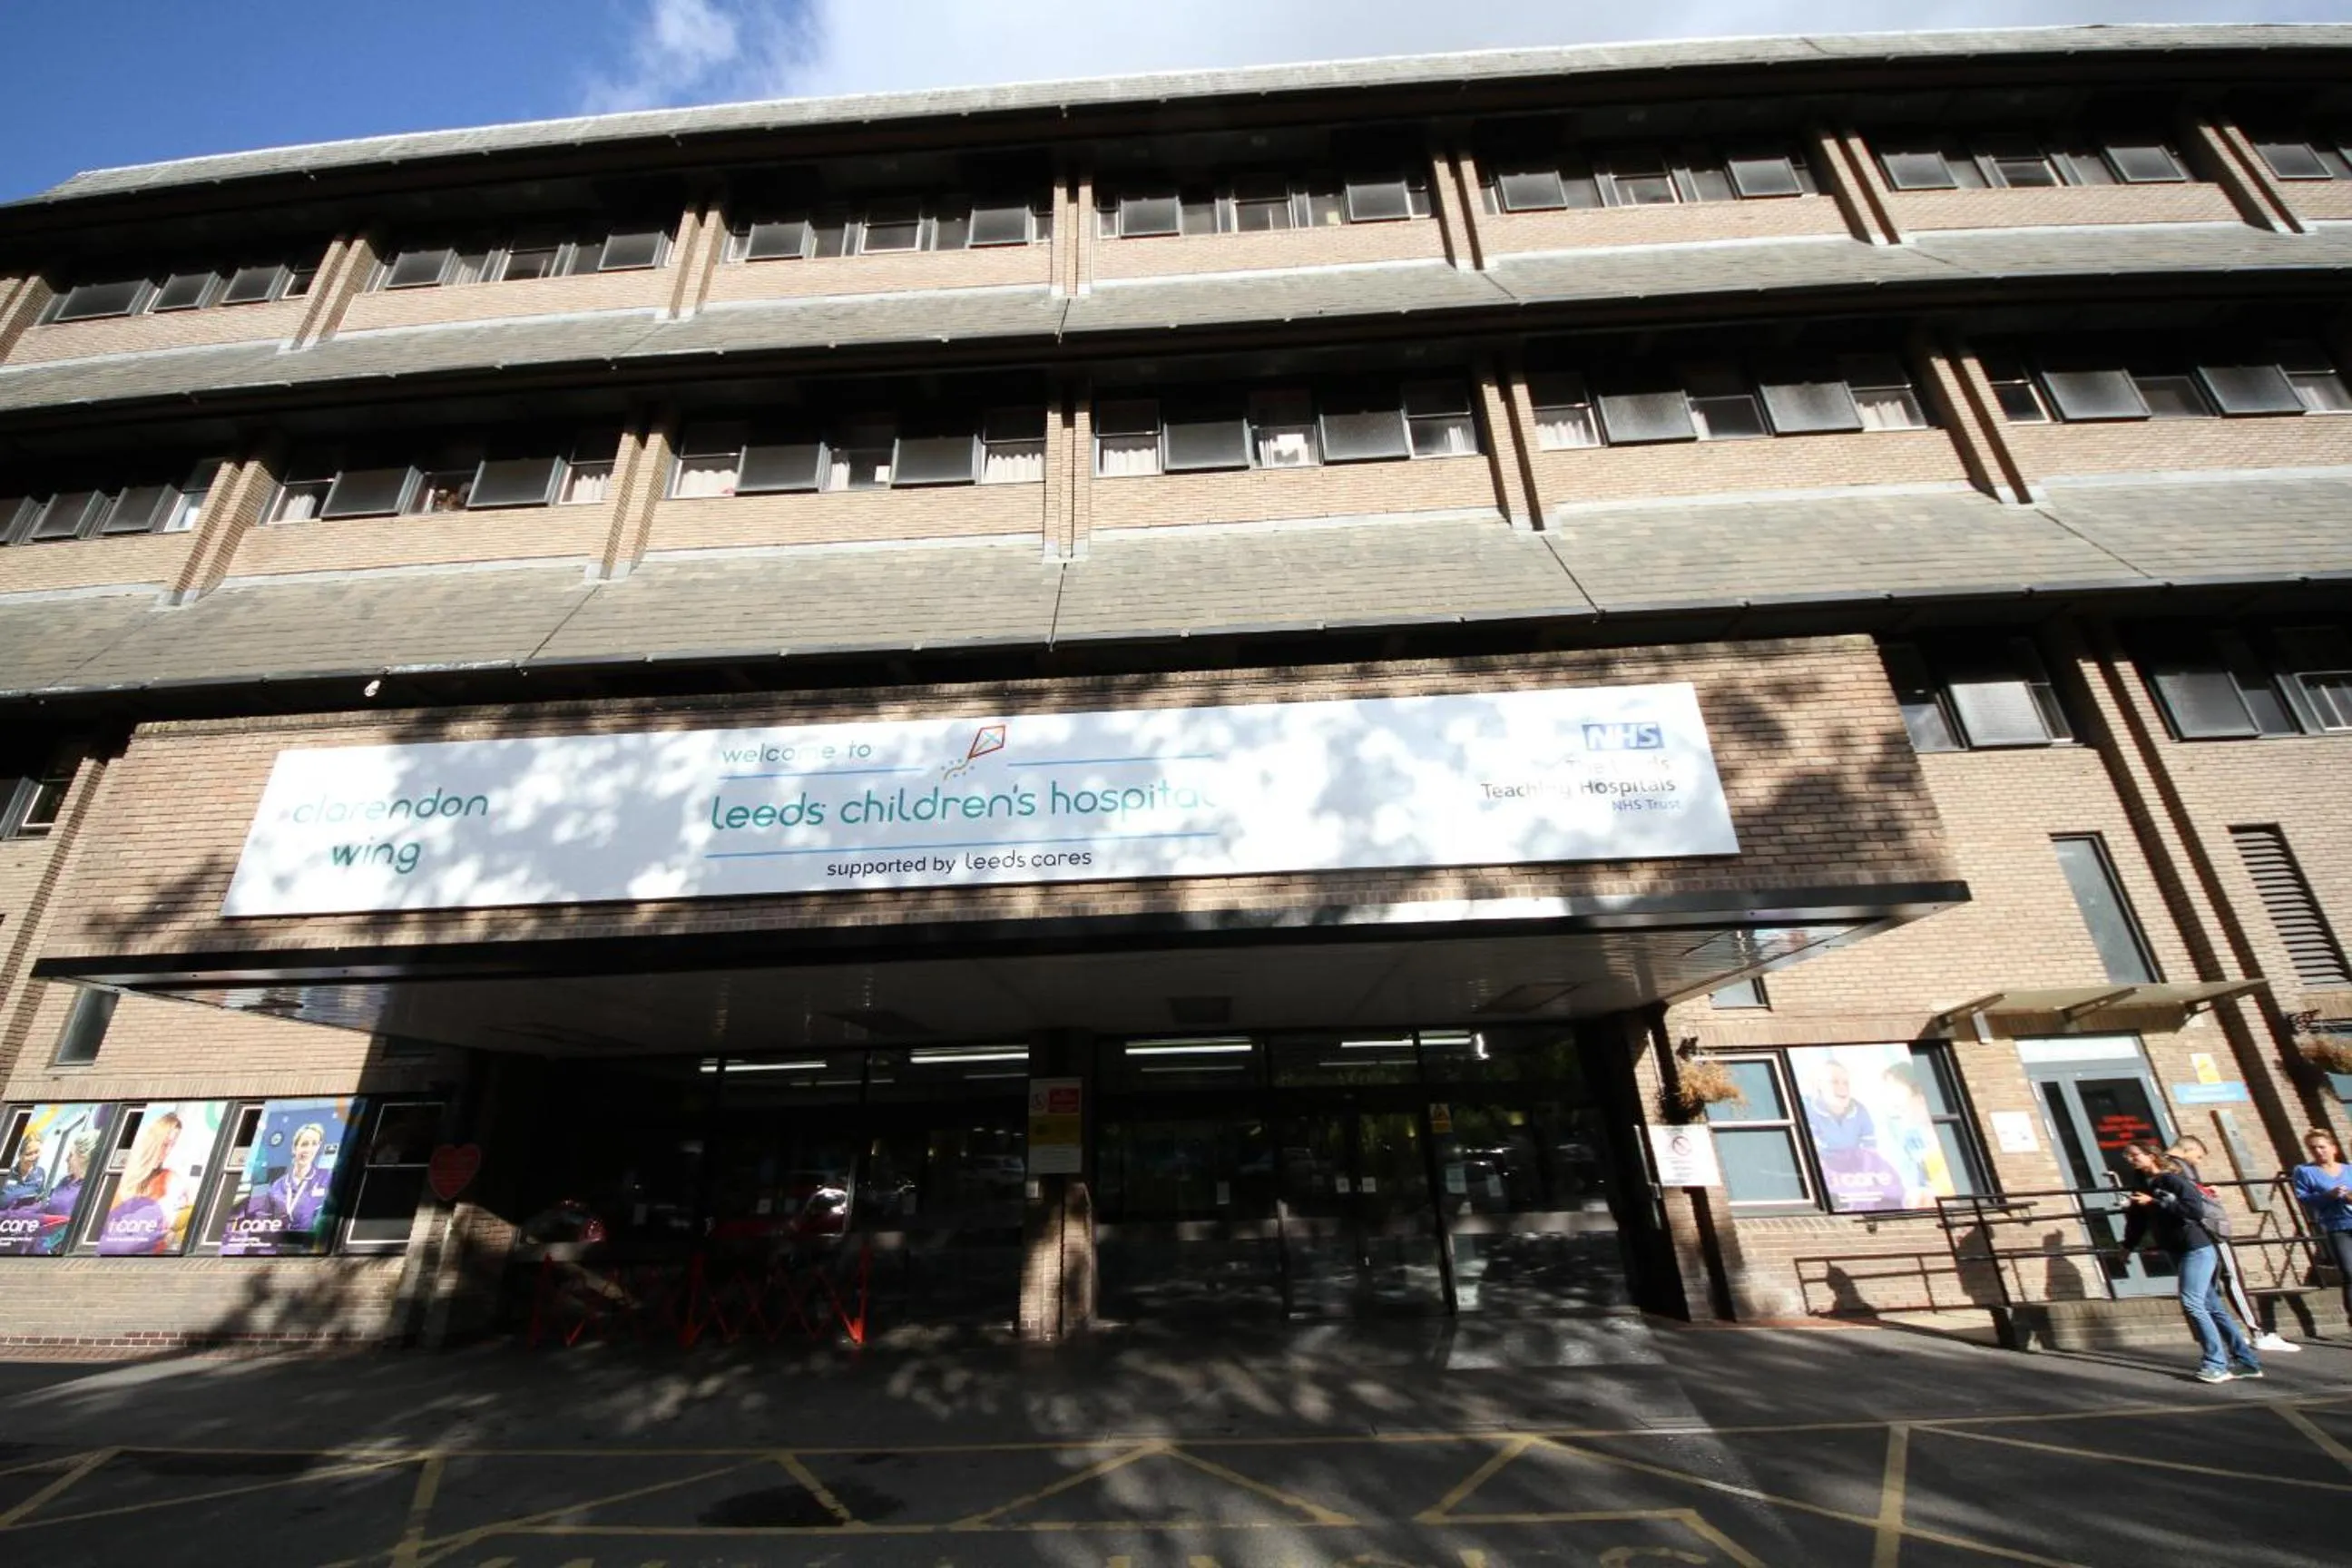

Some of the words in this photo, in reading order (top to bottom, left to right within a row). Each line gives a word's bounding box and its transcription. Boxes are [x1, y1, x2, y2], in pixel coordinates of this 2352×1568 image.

[1586, 723, 1661, 750] NHS
[722, 742, 836, 764] welcoe
[848, 740, 873, 760] to
[1481, 780, 1573, 800] Teachg
[1580, 778, 1677, 798] Hospitals
[292, 786, 489, 824] clarendon
[710, 794, 827, 831] leeds
[839, 782, 1036, 825] children's
[1050, 779, 1218, 822] hospital
[1612, 799, 1642, 811] NHS
[1644, 798, 1682, 810] Trust
[331, 834, 423, 876] wing
[827, 854, 927, 878] supported
[932, 854, 956, 875] by
[965, 850, 1026, 871] leeds
[1031, 850, 1093, 868] cares
